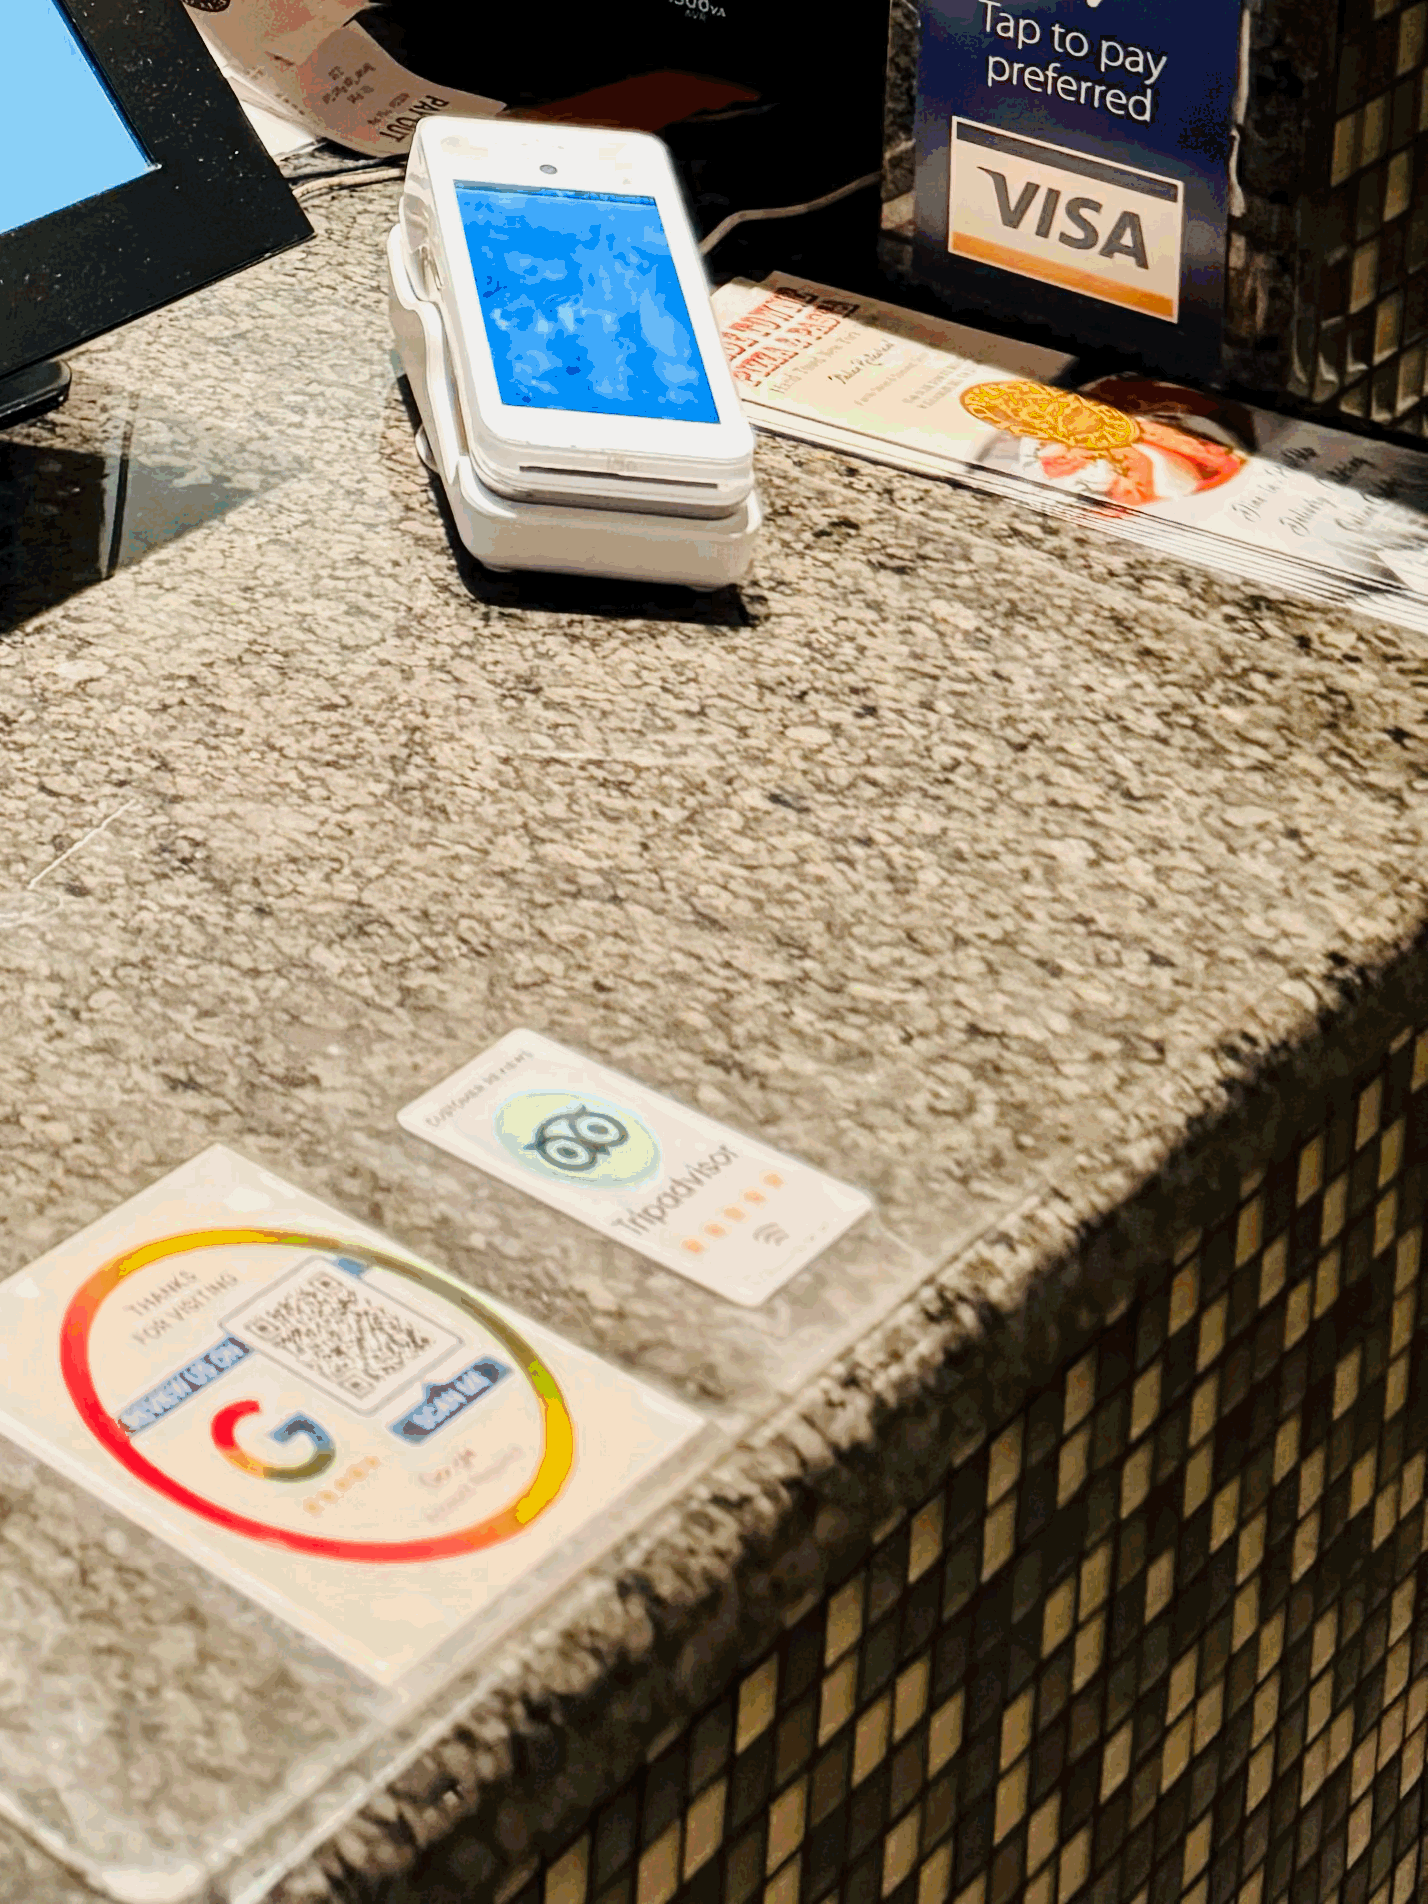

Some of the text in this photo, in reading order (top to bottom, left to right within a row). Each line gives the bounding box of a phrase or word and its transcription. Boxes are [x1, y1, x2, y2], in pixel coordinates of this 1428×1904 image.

[986, 51, 1154, 125] preferred
[1050, 18, 1090, 58] to
[1100, 34, 1168, 85] pay
[975, 165, 1150, 271] VISA
[612, 1144, 740, 1237] Tripadvisor
[122, 1269, 198, 1317] THANKS
[132, 1272, 239, 1347] FOR VISITING
